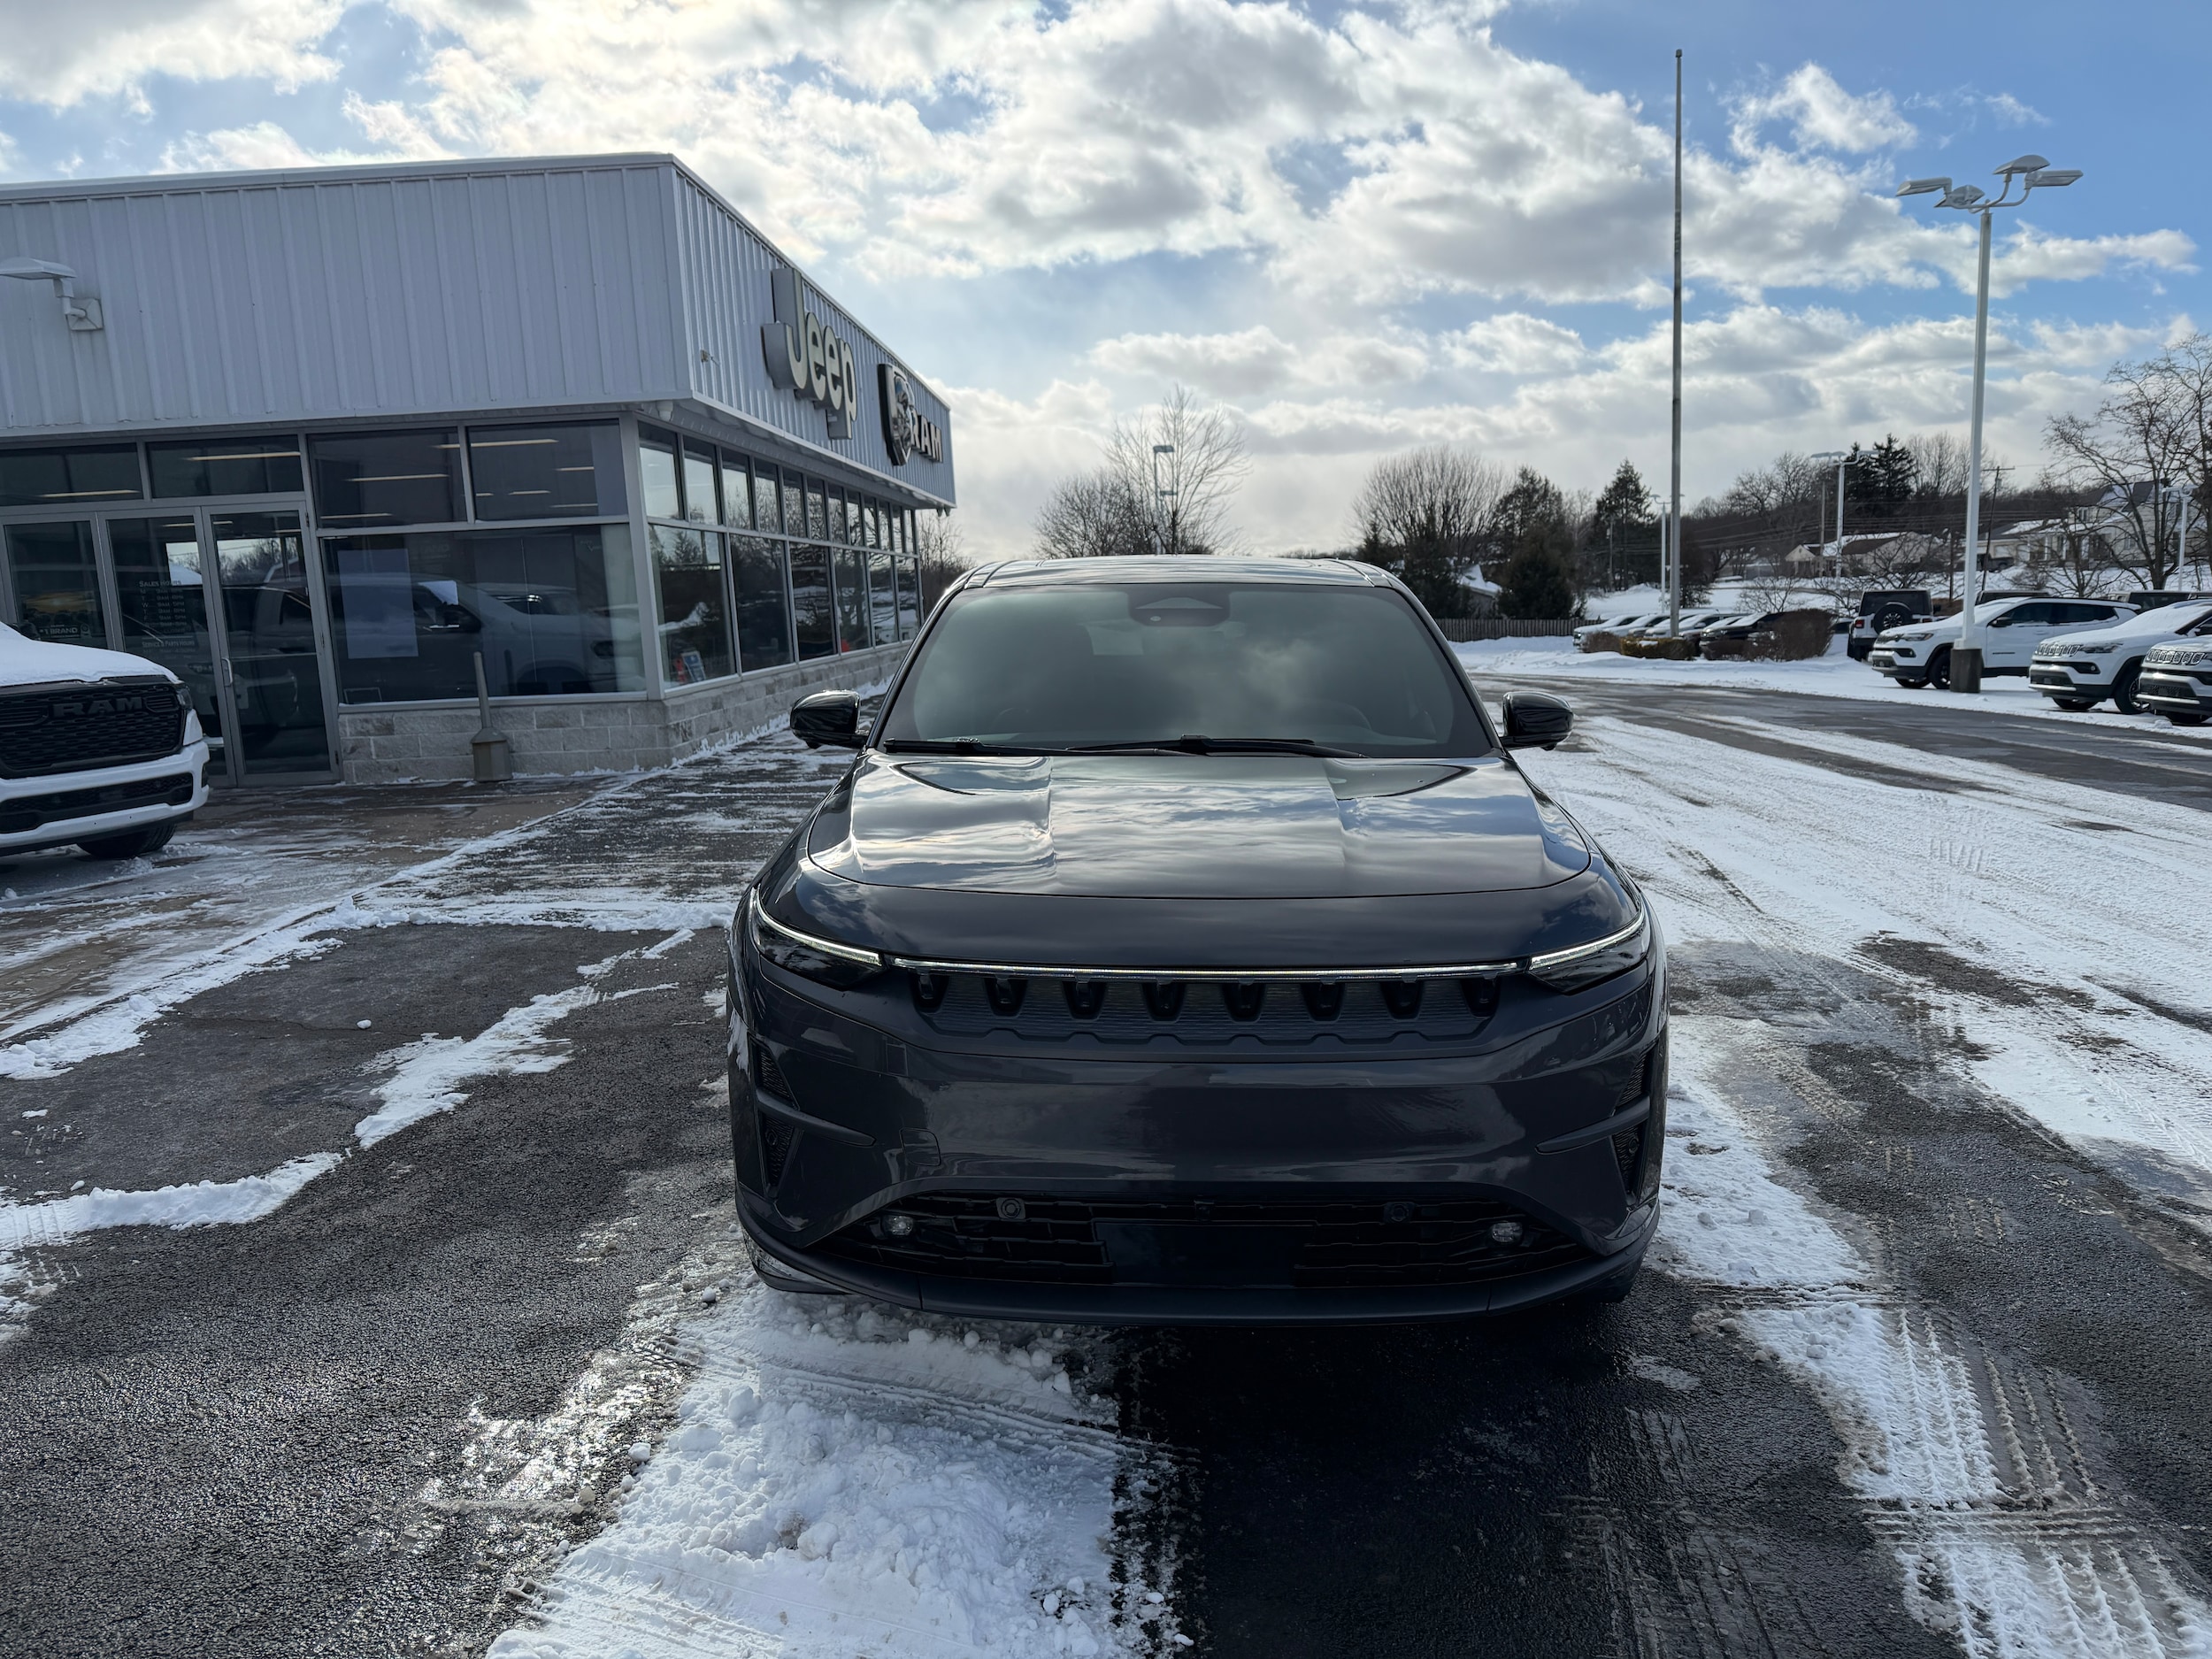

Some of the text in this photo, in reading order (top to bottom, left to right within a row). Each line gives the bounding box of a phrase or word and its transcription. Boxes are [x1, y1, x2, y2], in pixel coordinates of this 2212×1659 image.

[786, 268, 857, 439] Jeep
[910, 407, 942, 462] RAM
[53, 697, 142, 717] RAM
